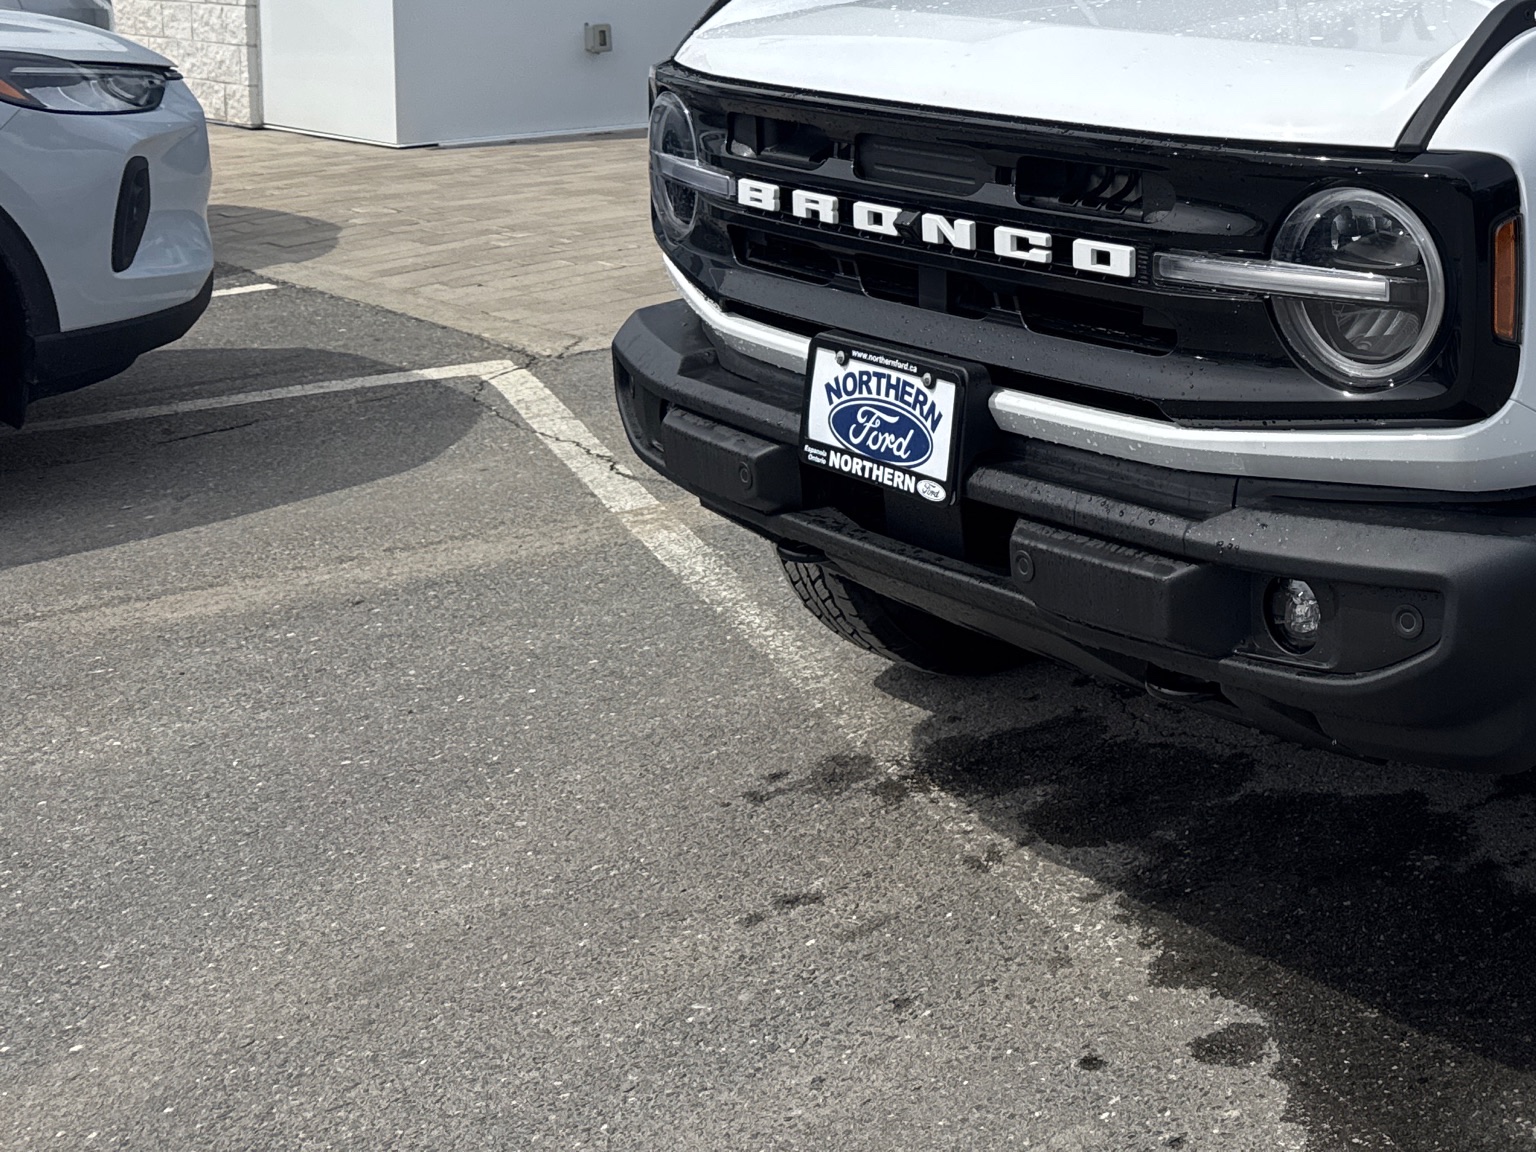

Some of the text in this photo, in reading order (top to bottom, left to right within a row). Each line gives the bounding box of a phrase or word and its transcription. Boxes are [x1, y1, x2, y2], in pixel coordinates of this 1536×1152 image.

[738, 178, 1136, 278] BRONCO
[851, 349, 918, 373] www.northernford.ca
[824, 371, 943, 433] NORTHERN
[849, 406, 914, 459] Ford
[829, 450, 916, 493] NORTHERN
[921, 482, 940, 498] Ford
